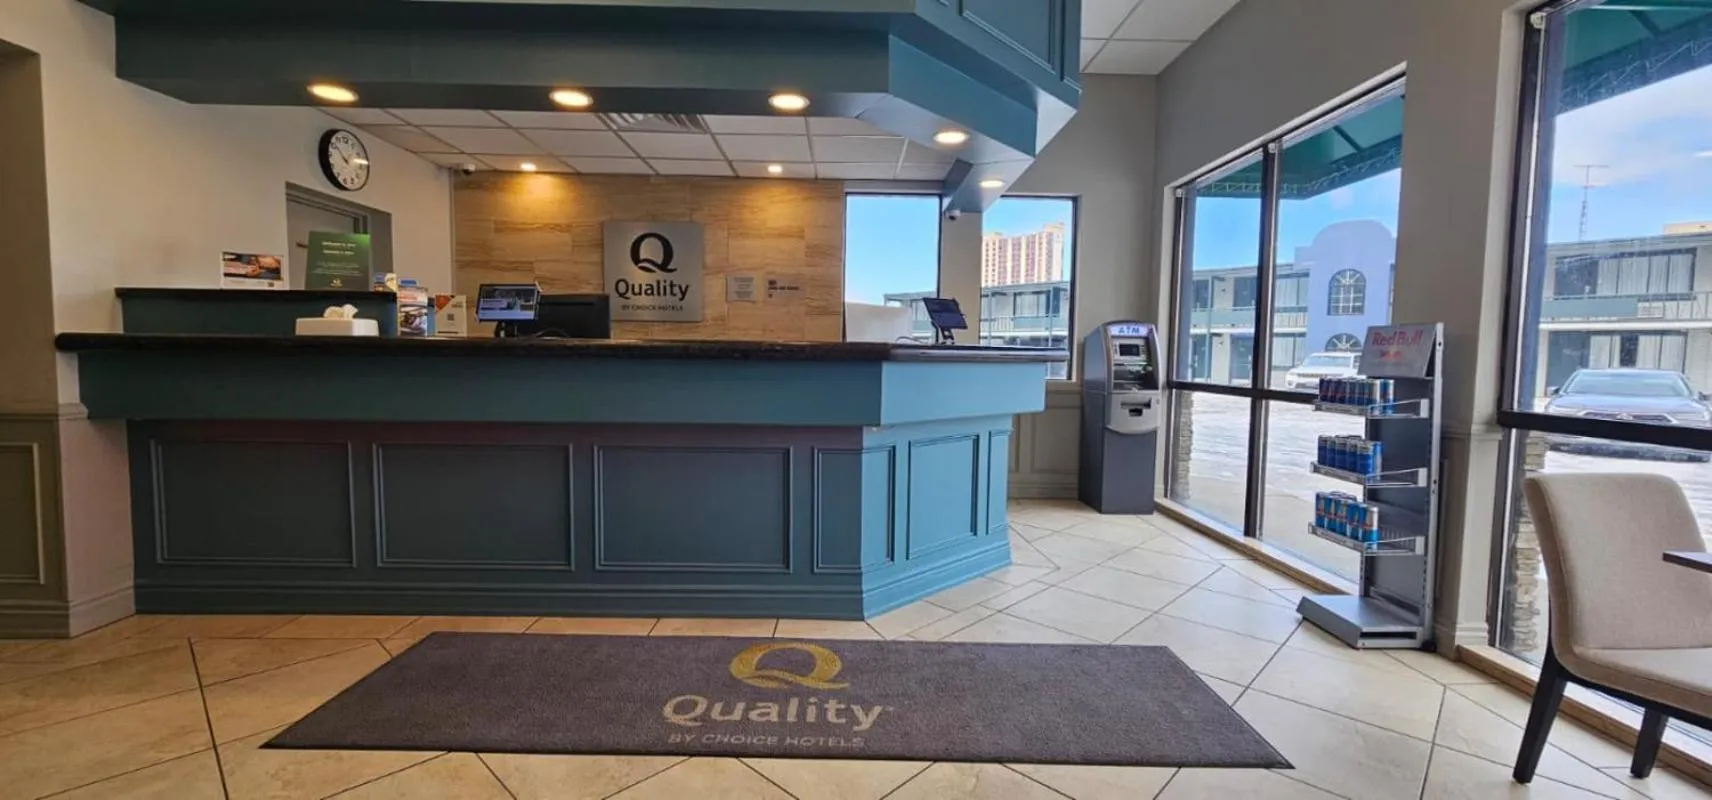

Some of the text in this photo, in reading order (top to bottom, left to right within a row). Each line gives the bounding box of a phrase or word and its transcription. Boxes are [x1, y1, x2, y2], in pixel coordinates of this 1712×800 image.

[630, 232, 678, 273] Q
[614, 278, 689, 302] Quality
[658, 304, 683, 312] HOTELS
[1118, 326, 1140, 334] ATM
[1372, 328, 1423, 345] Red Bull
[730, 642, 850, 690] Q
[662, 694, 883, 731] Quality
[667, 734, 866, 747] BY CHOICE HOTELS
